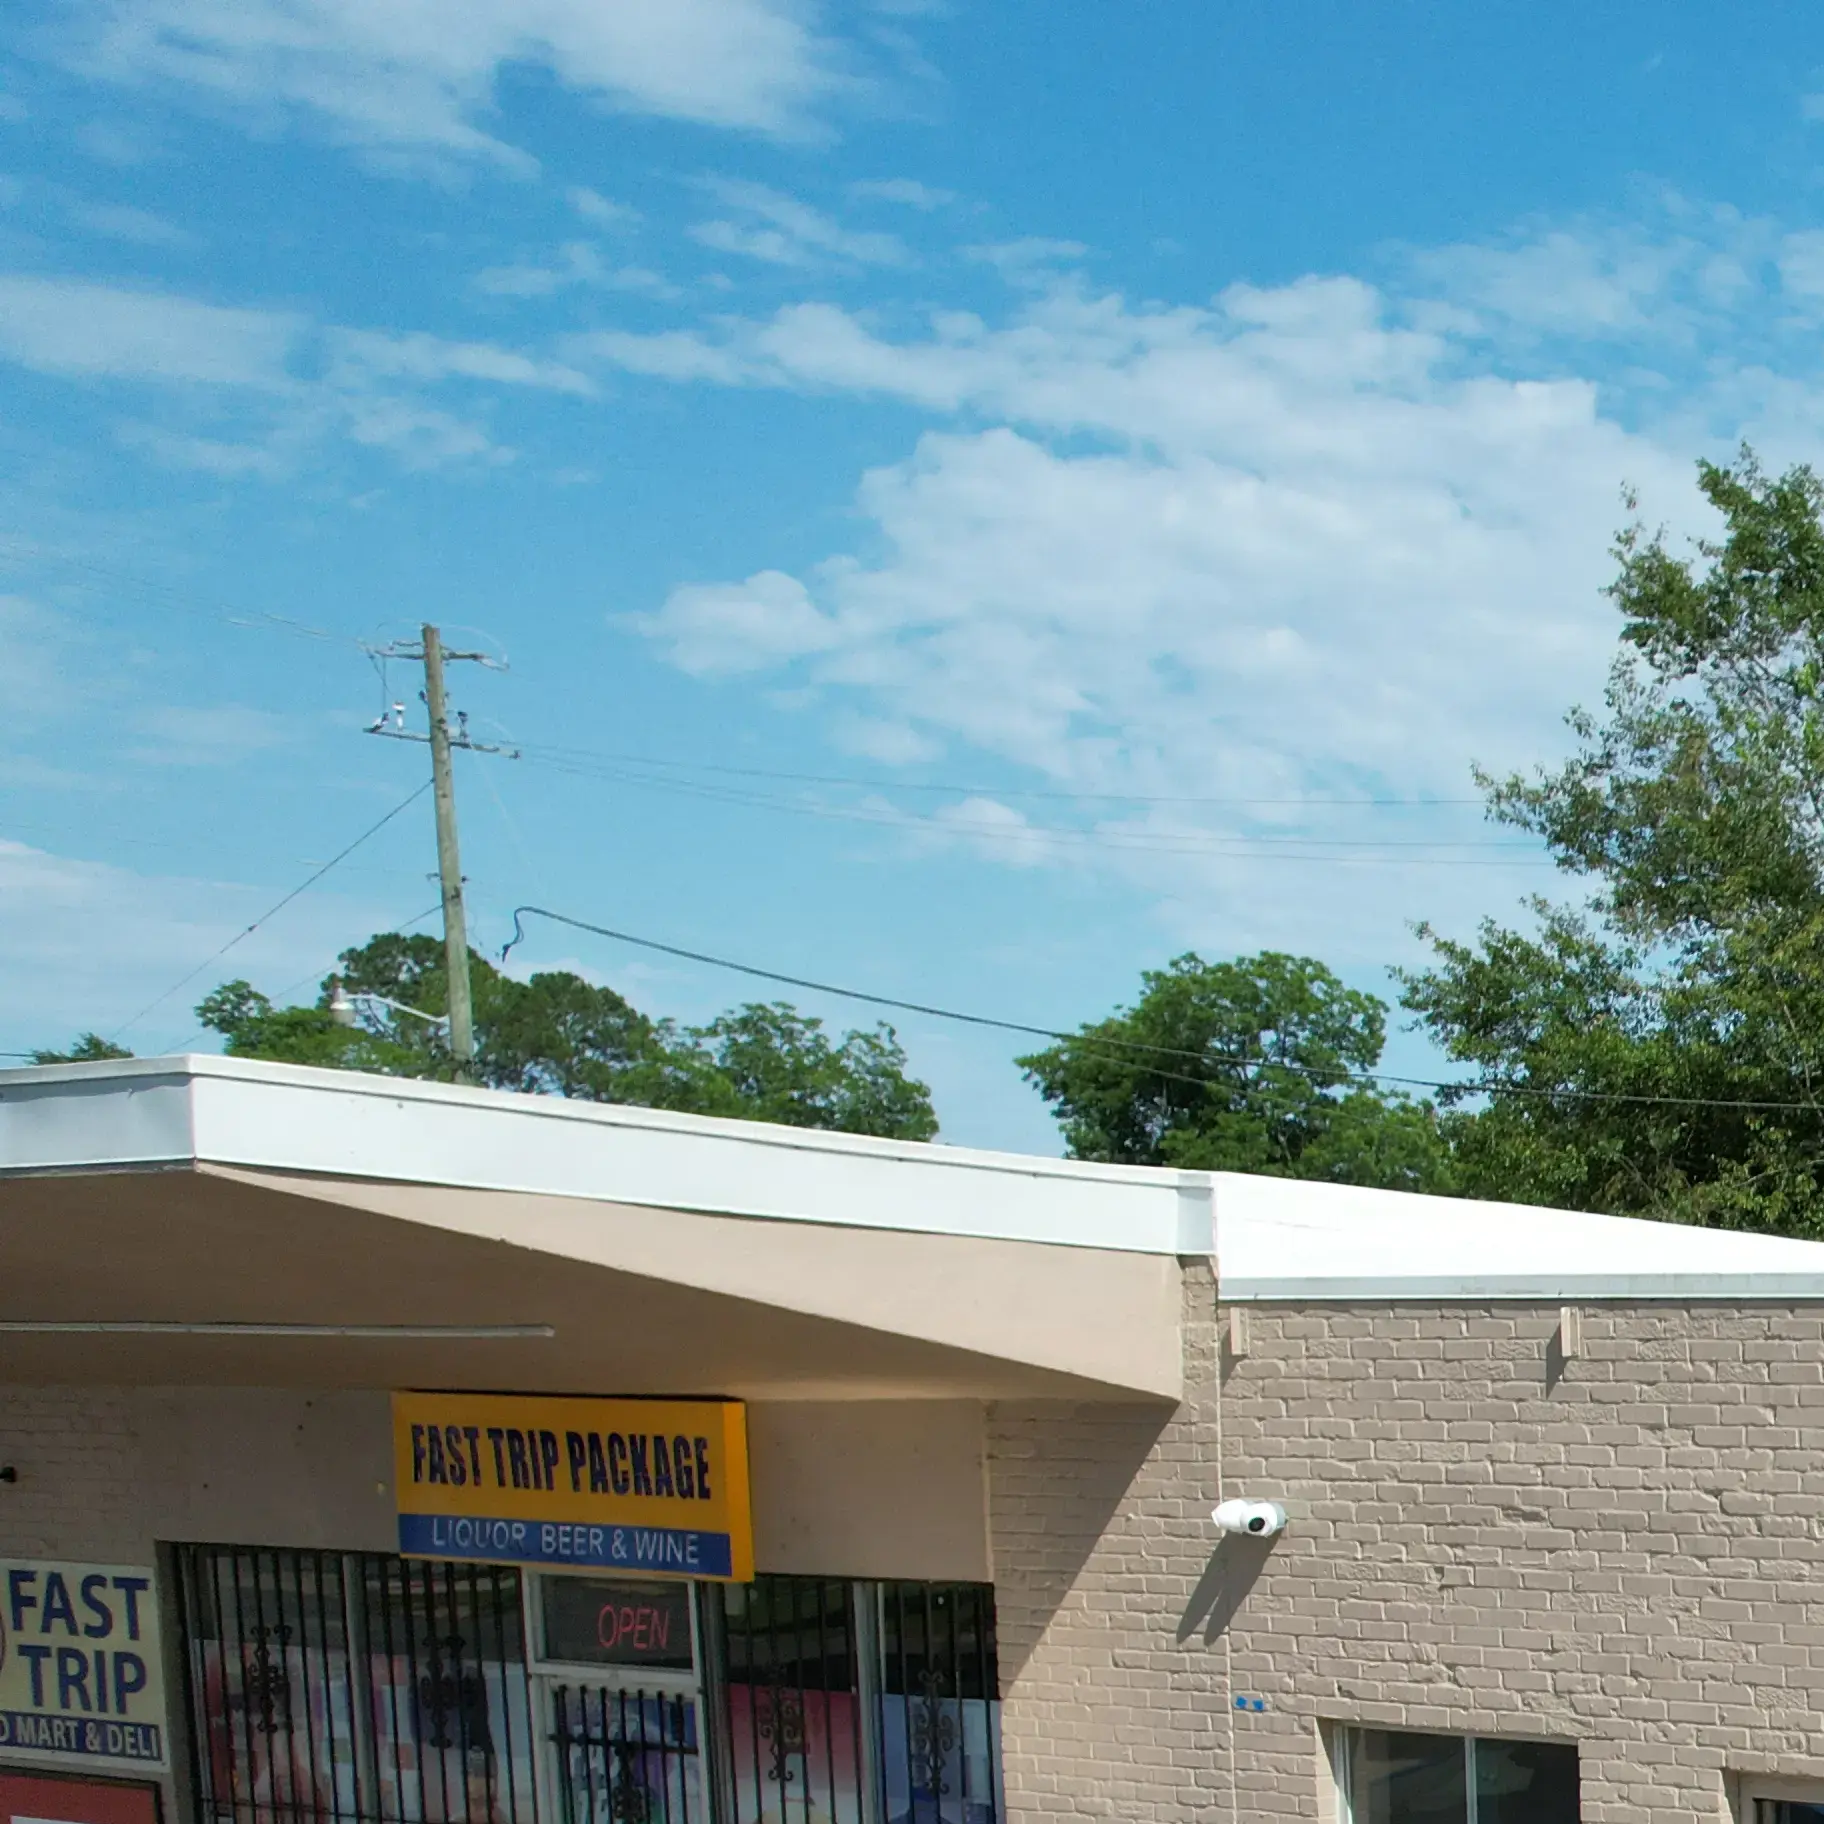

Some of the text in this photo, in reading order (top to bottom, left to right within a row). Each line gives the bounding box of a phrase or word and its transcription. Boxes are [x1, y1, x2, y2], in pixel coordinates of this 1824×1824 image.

[411, 1423, 711, 1500] FAST TRIP PACKAGE
[432, 1518, 700, 1564] LIQUOR BEER & WINE
[8, 1569, 150, 1641] FAST
[597, 1604, 670, 1650] OPEN
[17, 1644, 147, 1715] TRIP
[17, 1715, 79, 1749] MART
[85, 1721, 99, 1751] &
[107, 1723, 160, 1757] DELI
